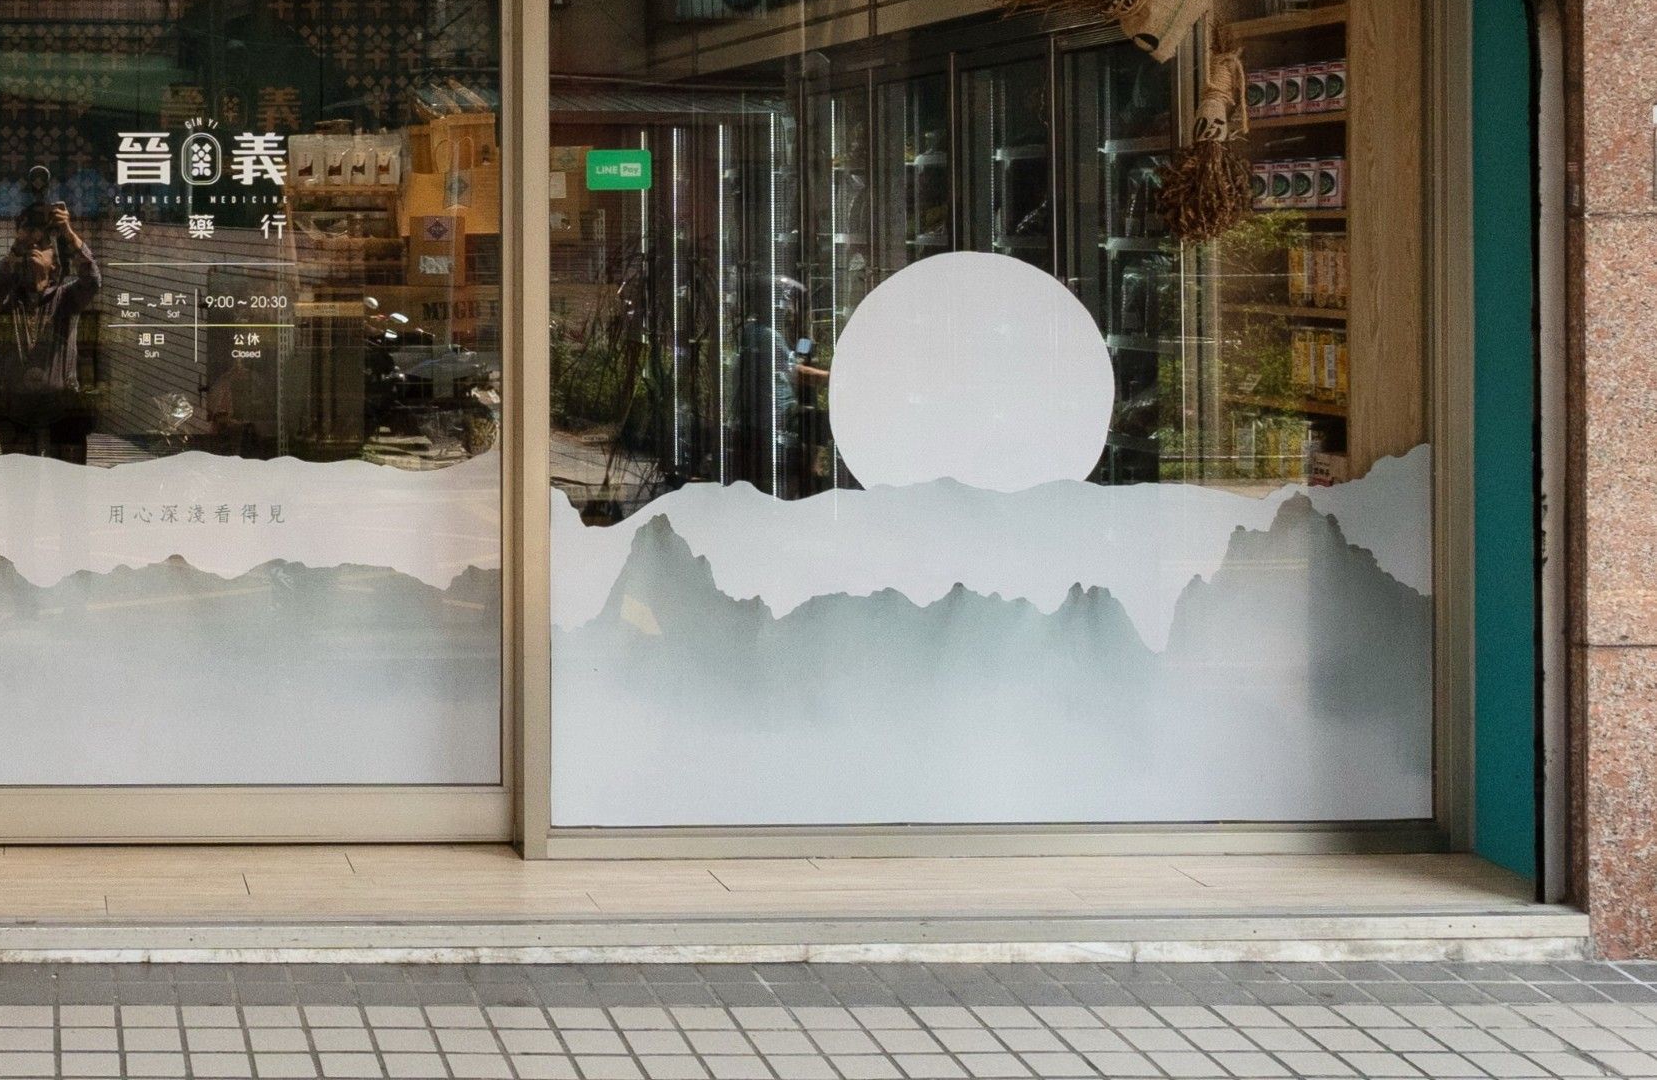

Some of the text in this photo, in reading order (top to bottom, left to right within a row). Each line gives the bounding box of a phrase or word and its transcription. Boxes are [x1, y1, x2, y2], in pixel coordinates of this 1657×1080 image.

[184, 116, 220, 130] GIN YI
[115, 131, 288, 186] 晉 義
[595, 165, 619, 175] LINE
[114, 195, 289, 205] CHINESE MEDICINE
[250, 295, 288, 309] 20:30
[120, 309, 181, 319] Mon Sat
[138, 332, 261, 346] 週日 公休
[144, 349, 261, 359] Sun Closed
[108, 503, 286, 524] 用心深淺看得見
